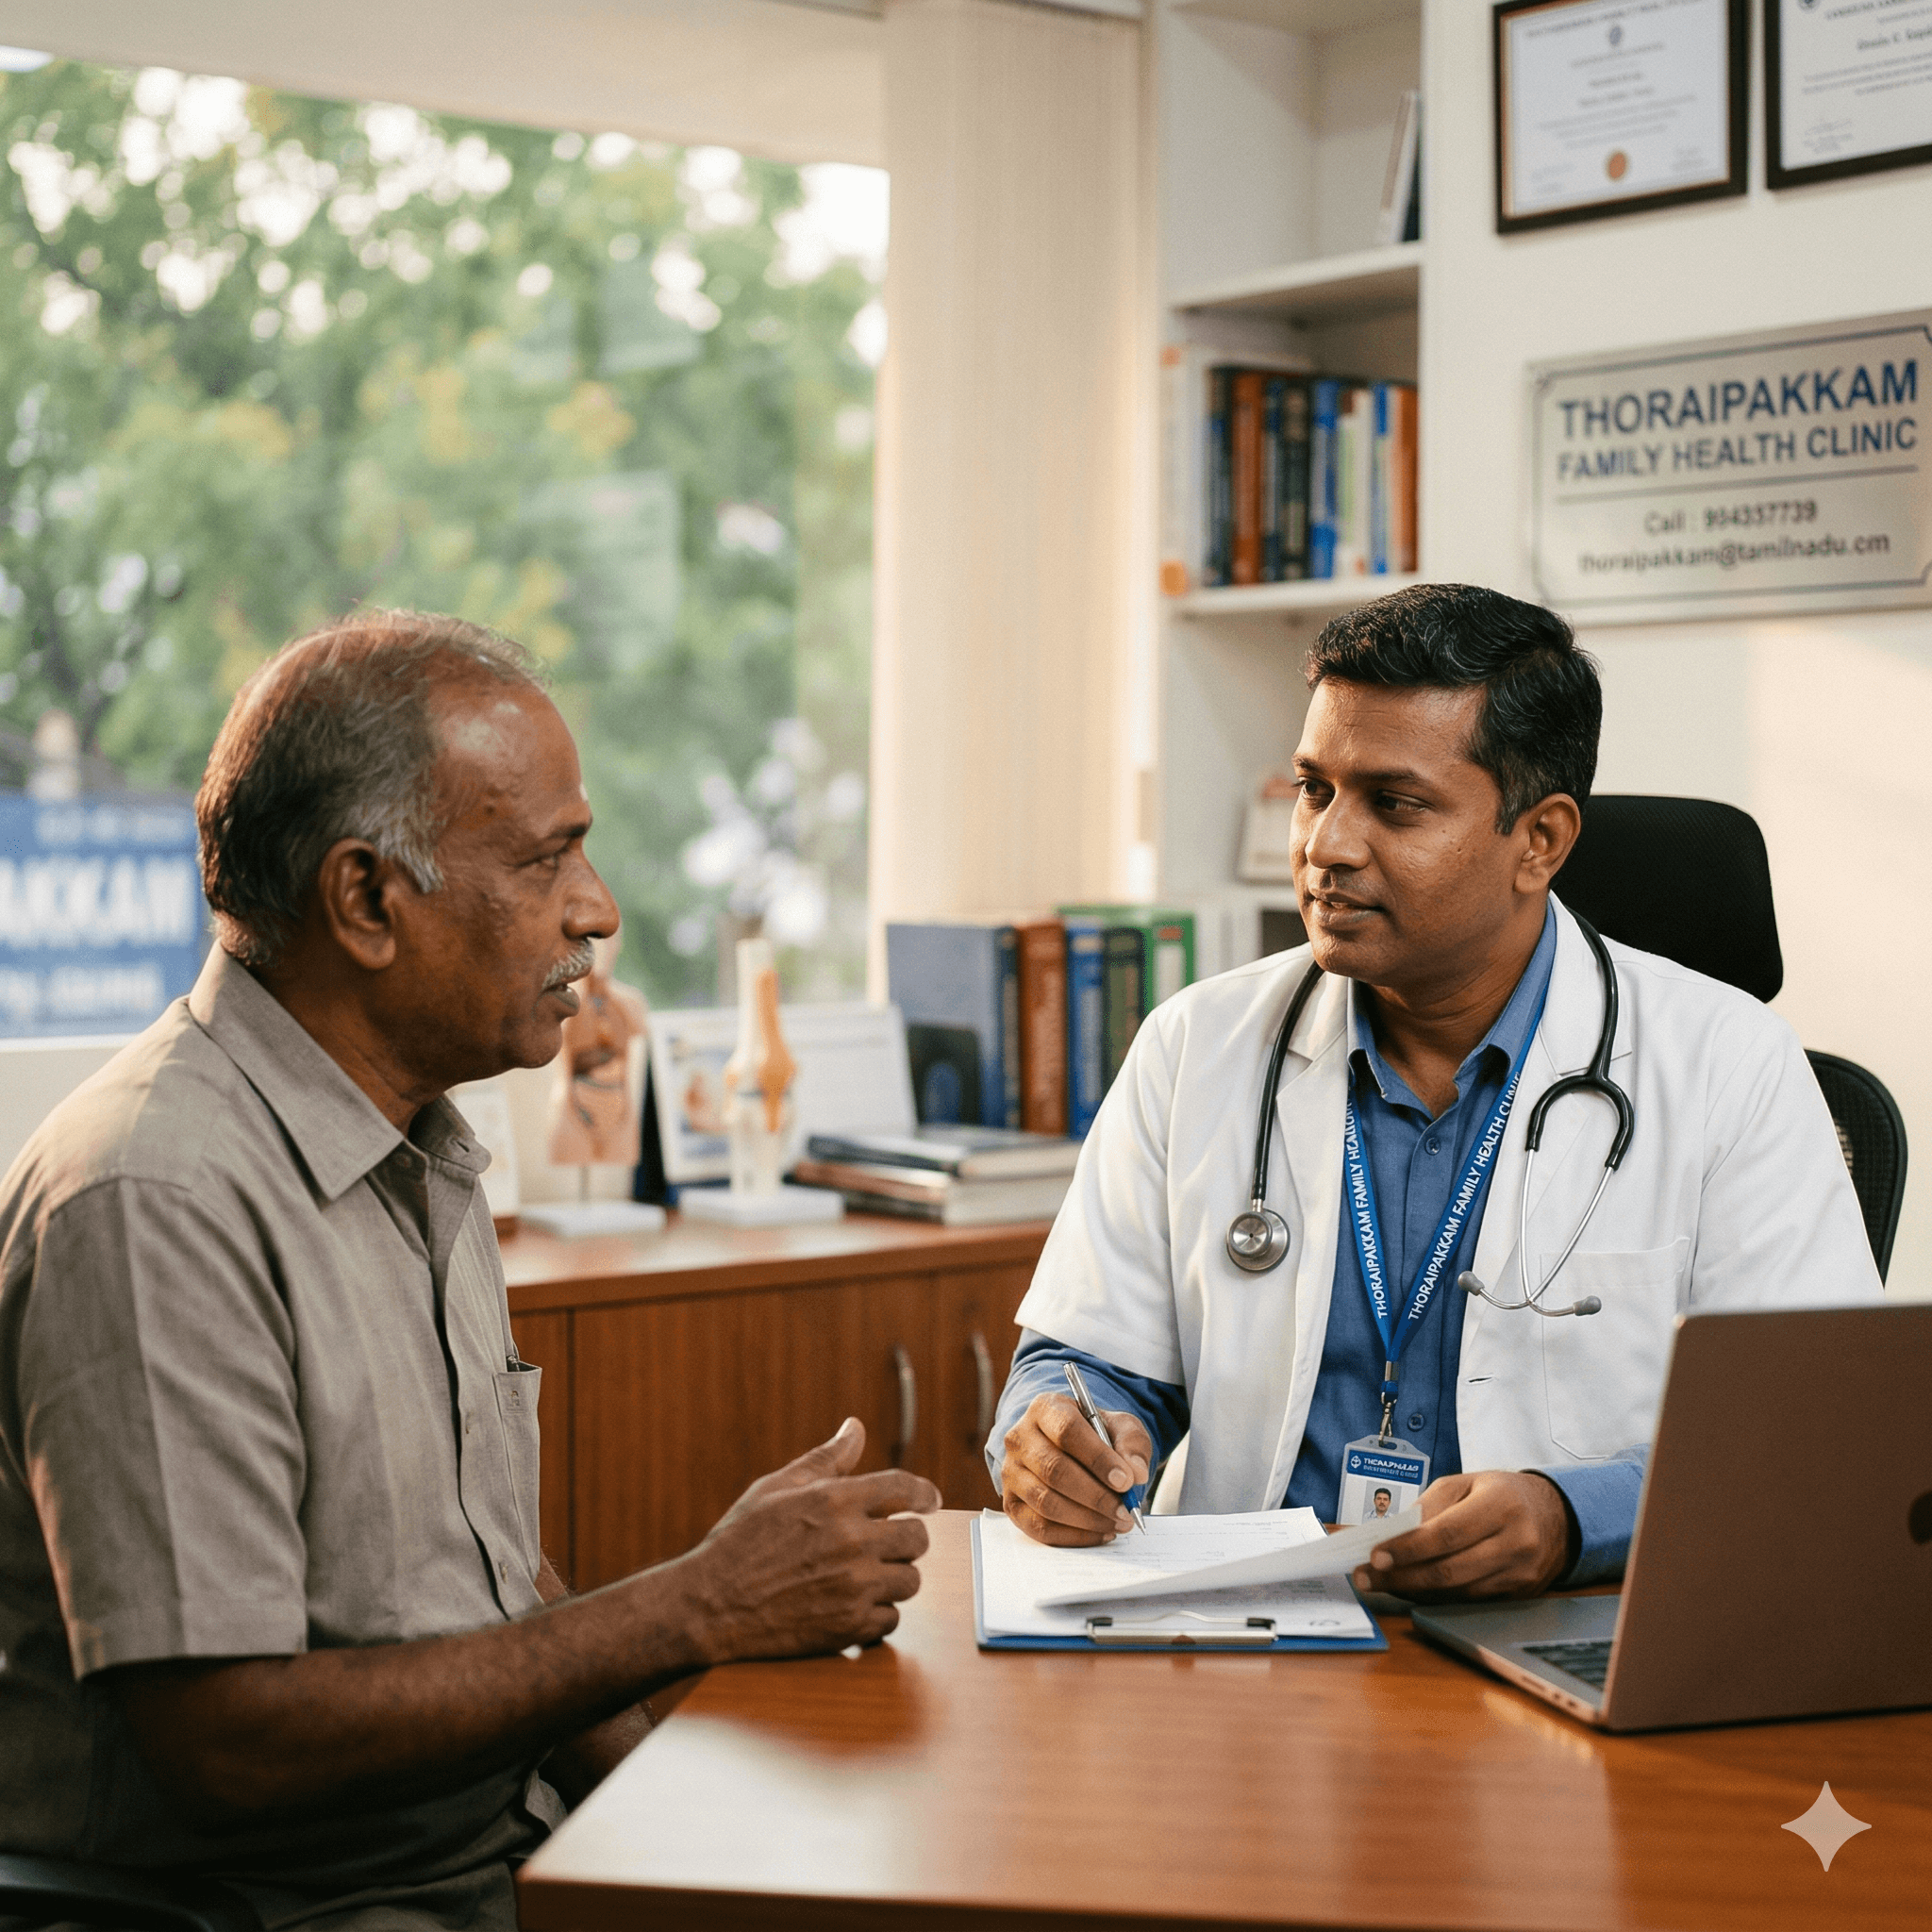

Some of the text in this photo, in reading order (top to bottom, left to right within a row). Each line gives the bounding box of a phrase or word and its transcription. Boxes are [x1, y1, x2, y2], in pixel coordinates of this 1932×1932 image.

[1557, 358, 1919, 440] THORAIPAKKAM
[1557, 417, 1917, 483] FAMILY HEALTH CLINIC
[1643, 509, 1686, 536] Call
[1349, 1163, 1369, 1208] FAMILY
[1407, 1216, 1461, 1320] THORAIPAKKAM
[1453, 1166, 1482, 1216] FAMILY
[1474, 1116, 1507, 1168] HEALTH
[1357, 1210, 1388, 1319] THORAIPAKKAM
